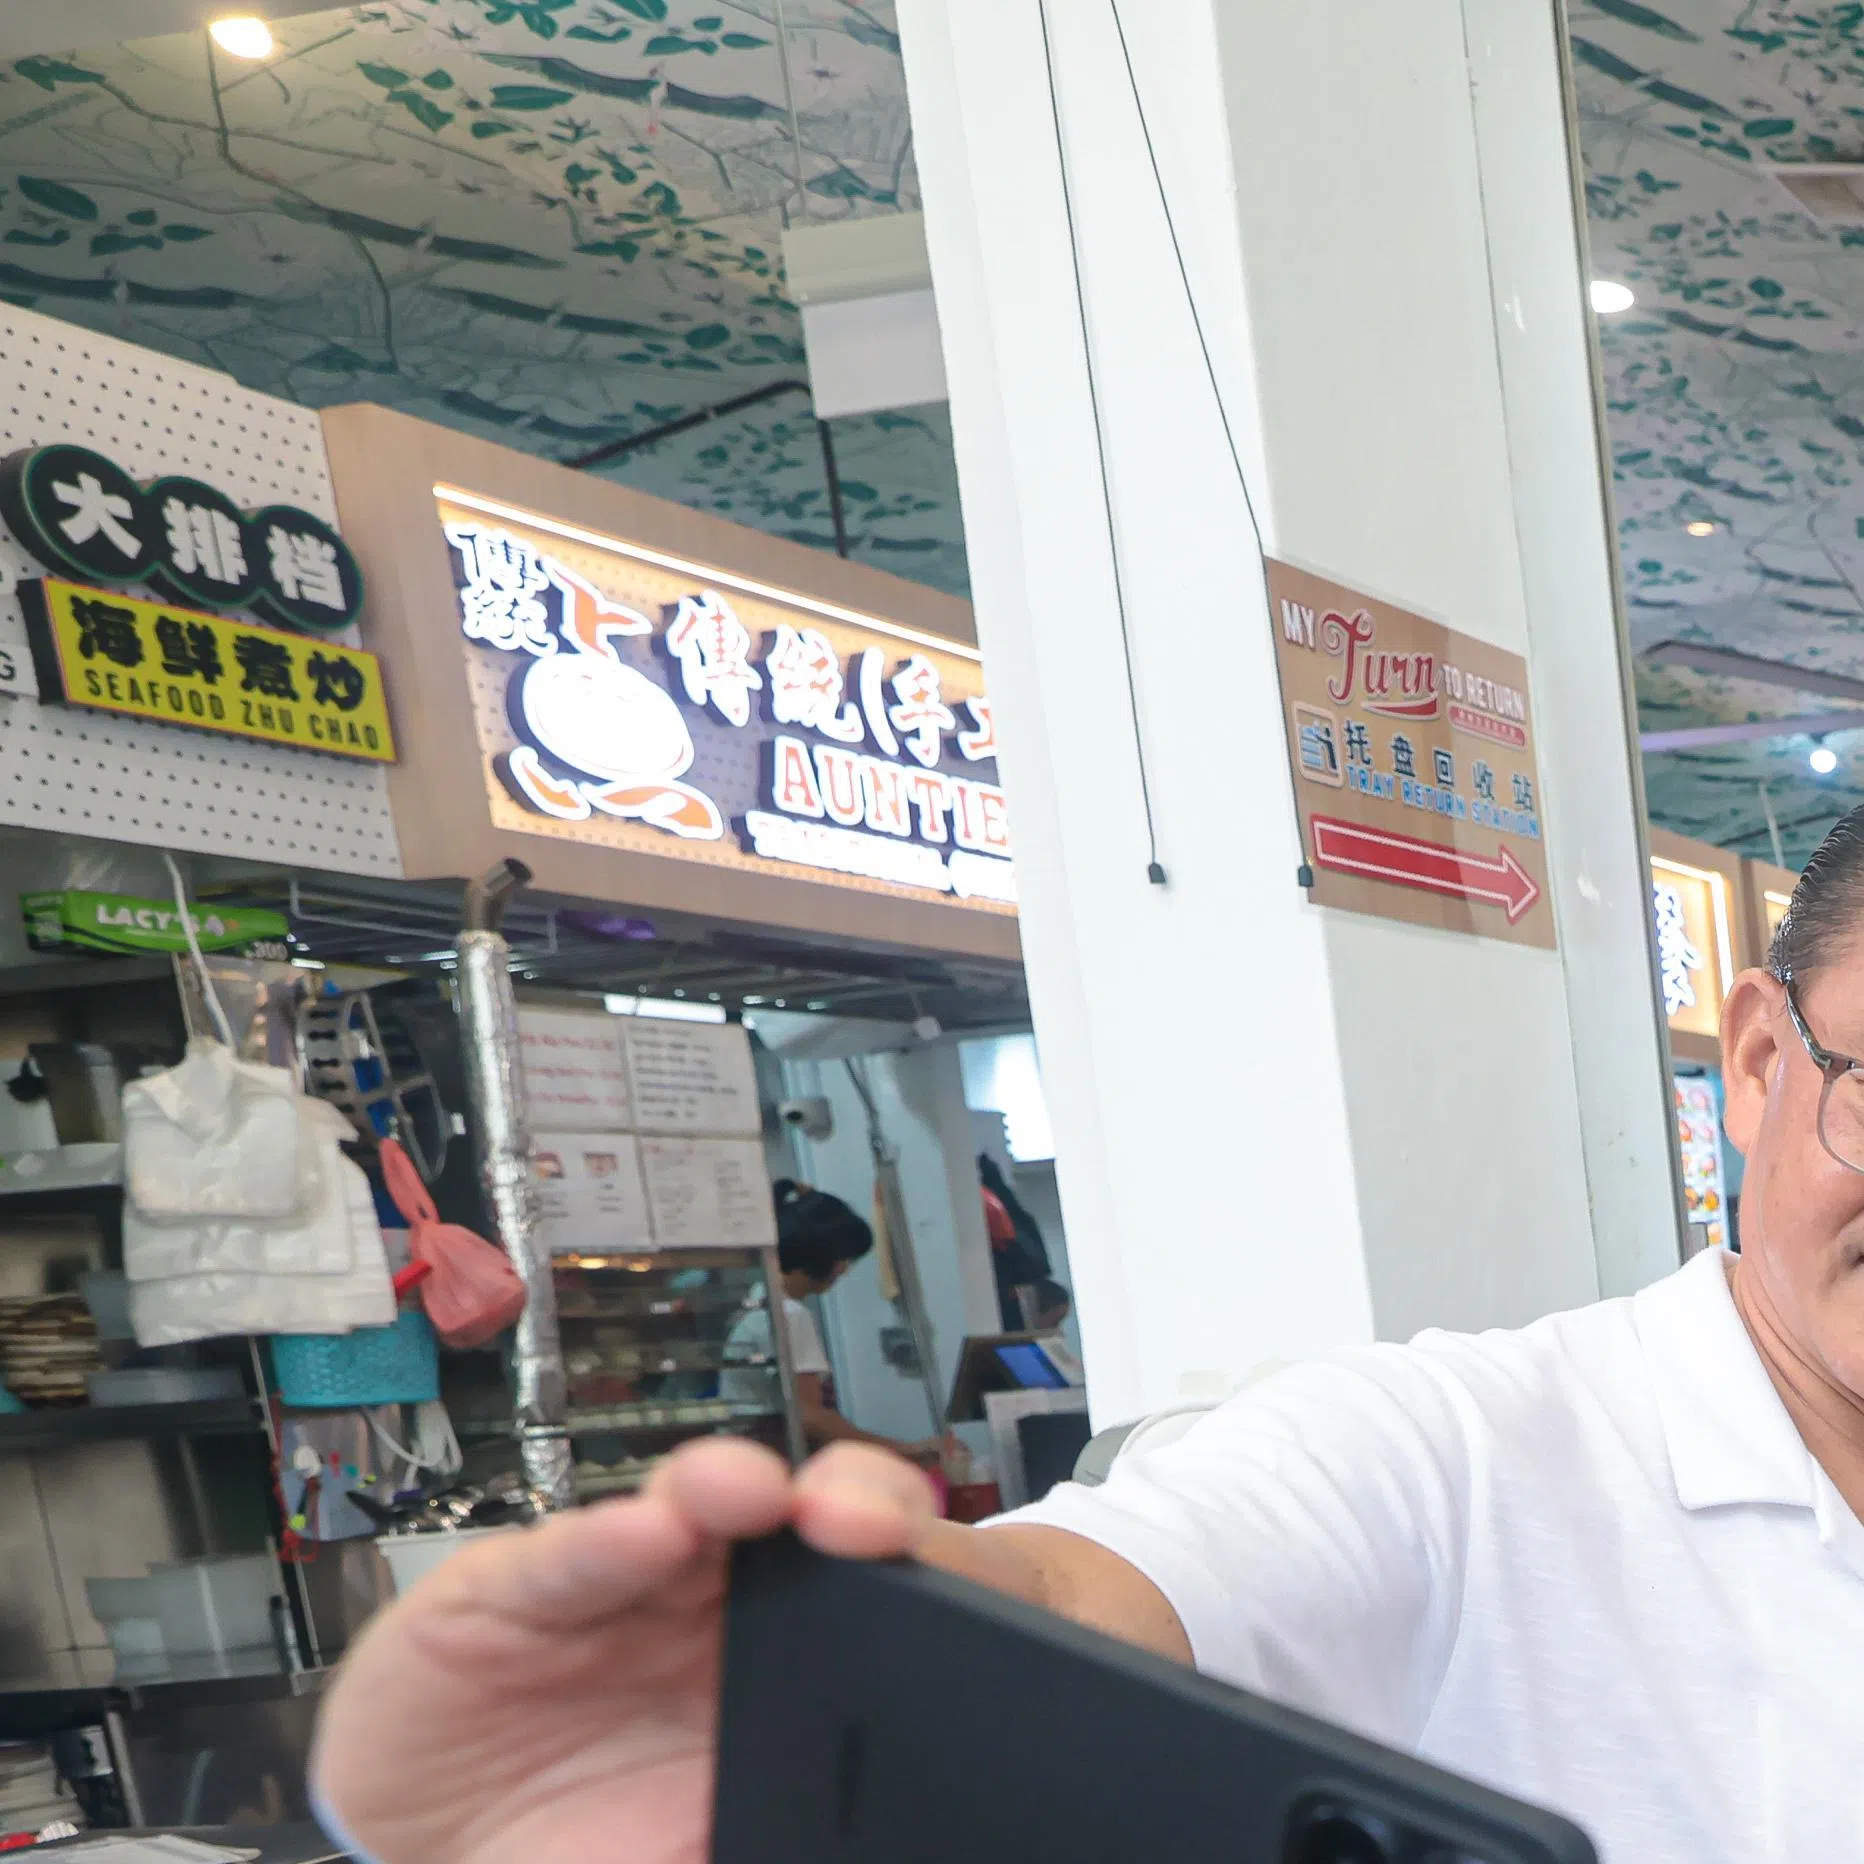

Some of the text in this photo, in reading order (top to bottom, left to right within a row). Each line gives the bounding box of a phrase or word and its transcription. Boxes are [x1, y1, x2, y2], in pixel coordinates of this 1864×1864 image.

[51, 470, 347, 612] 大排档
[70, 594, 365, 712] 海鲜煮炒
[1280, 598, 1316, 649] MY
[1321, 609, 1441, 708] Turn
[84, 669, 380, 751] SEAFOOD ZHU CHAO
[1442, 664, 1525, 722] TO RETURN
[1344, 719, 1534, 812] 托盘回收站
[1345, 763, 1541, 840] TRAY RETURN STATION
